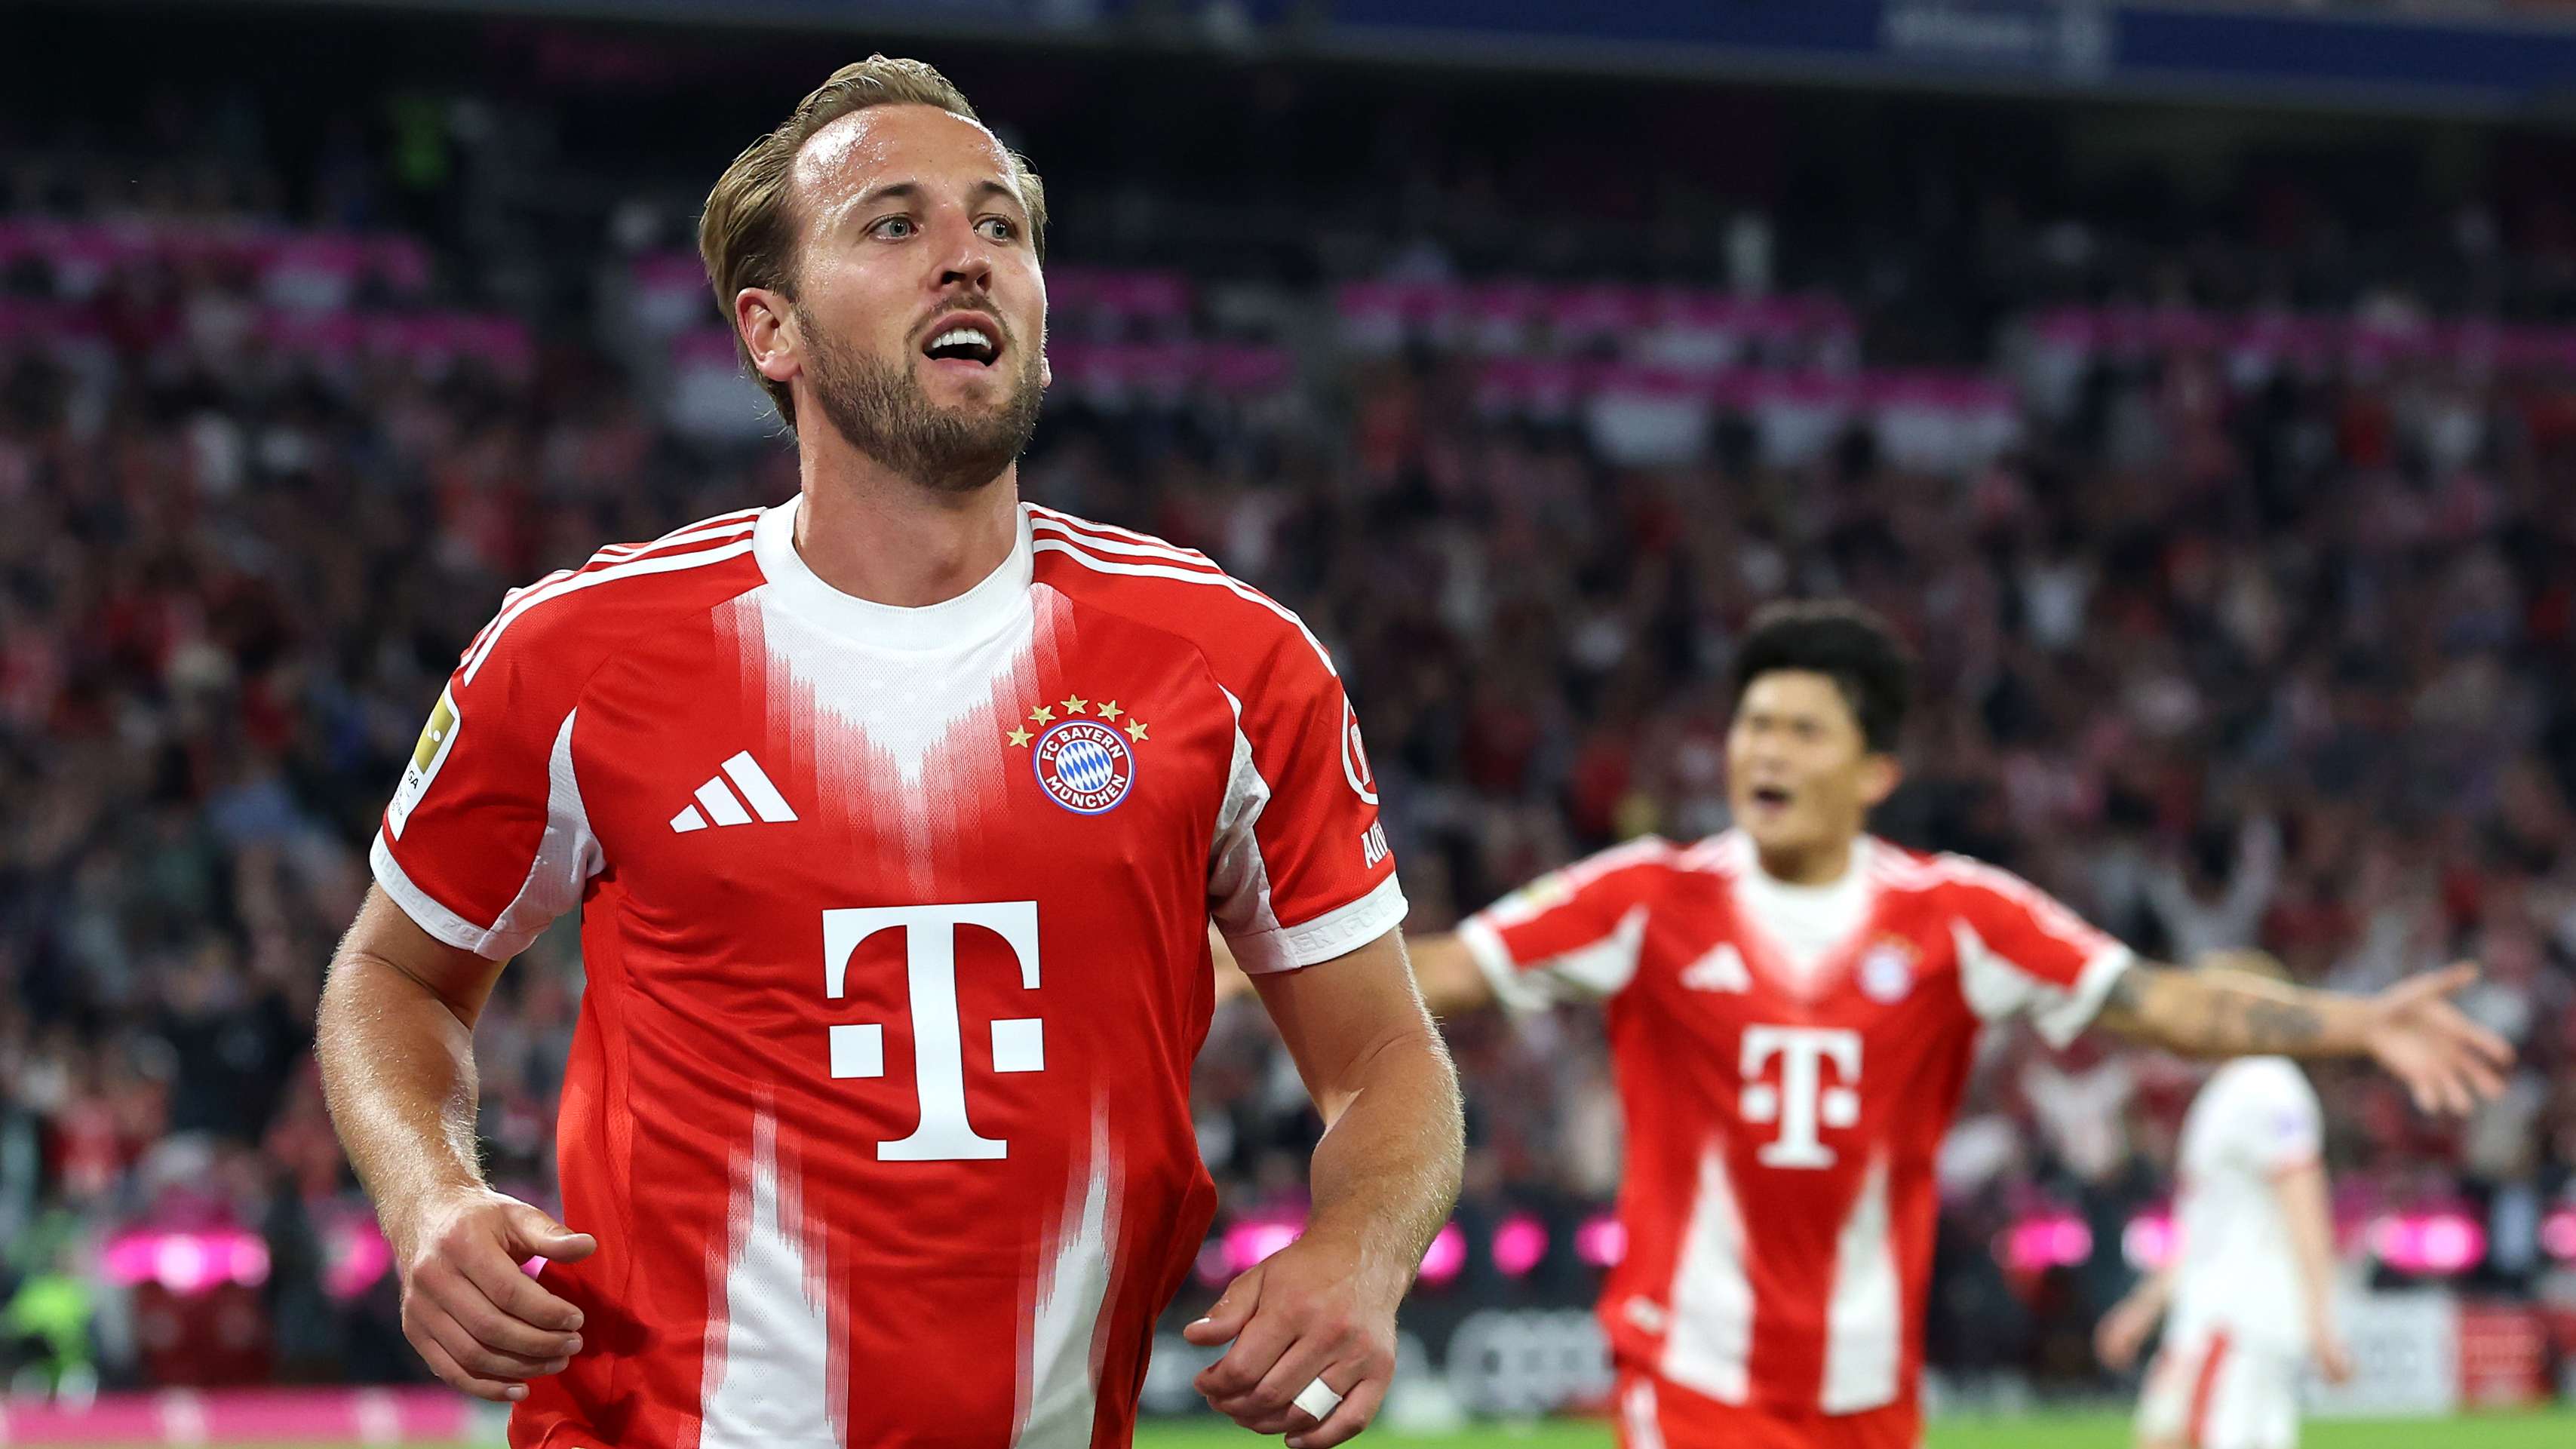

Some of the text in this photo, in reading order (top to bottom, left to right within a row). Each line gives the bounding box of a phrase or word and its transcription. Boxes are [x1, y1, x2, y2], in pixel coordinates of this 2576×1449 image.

[1042, 726, 1124, 760] FC BAYERN
[1046, 775, 1126, 808] MÜNCHEN
[822, 901, 1044, 1162] T
[1739, 1022, 1863, 1170] T
